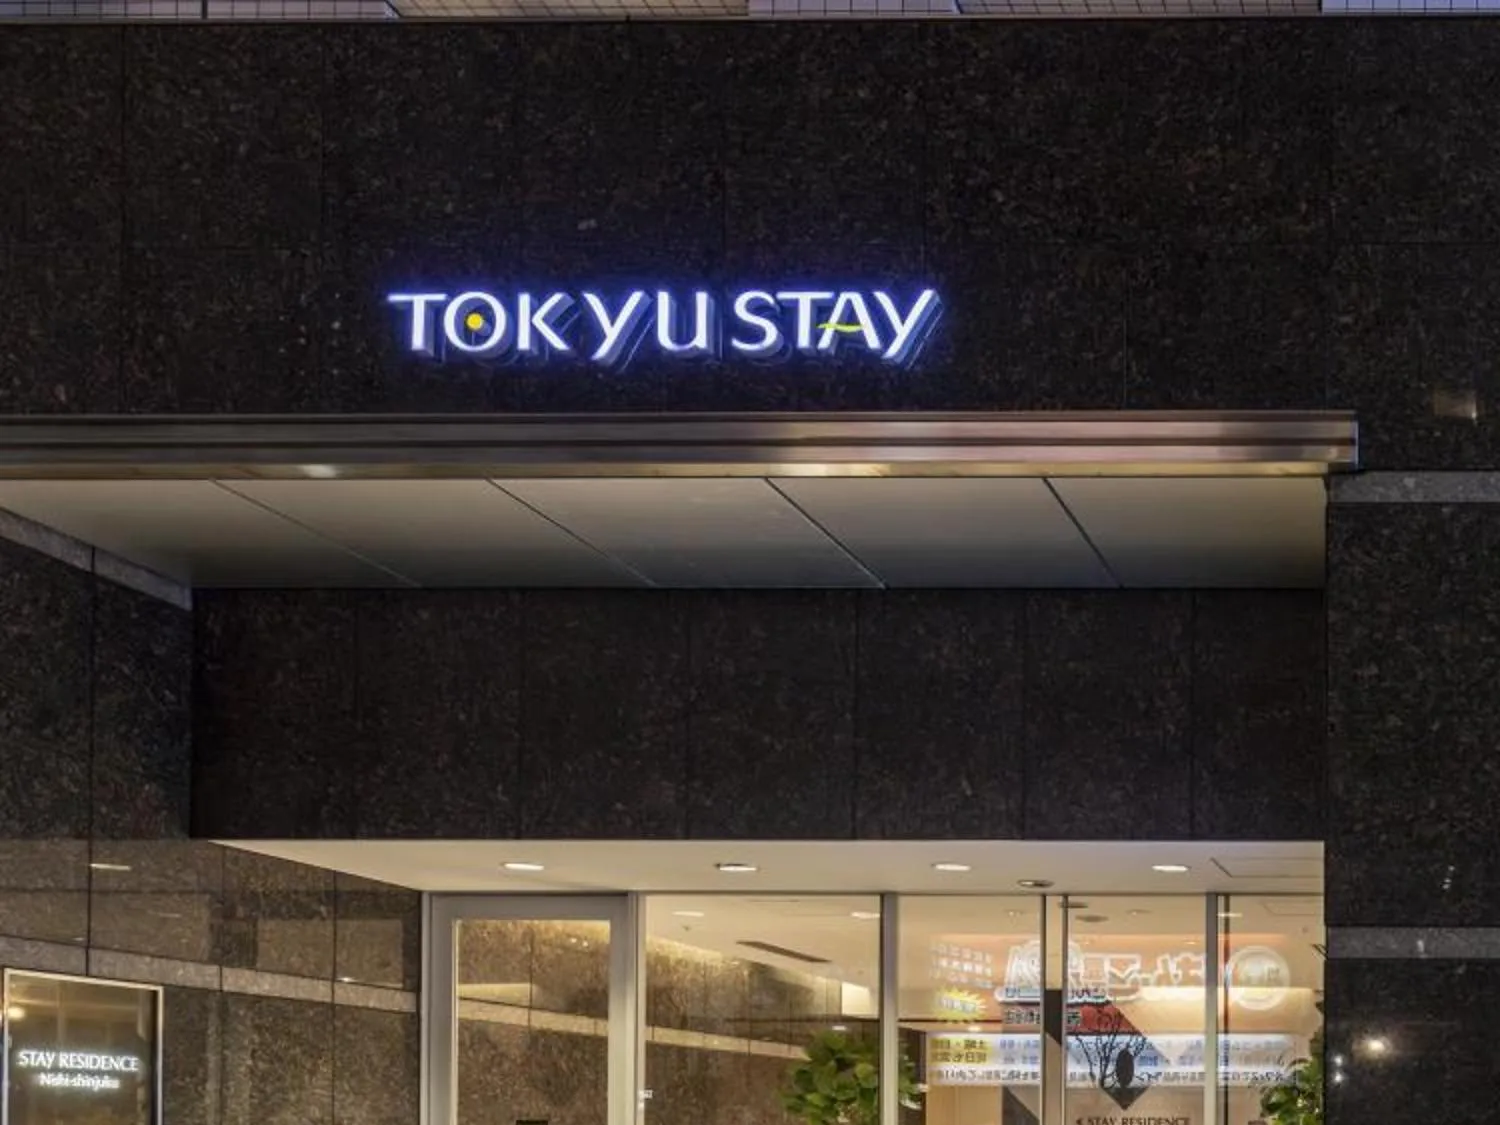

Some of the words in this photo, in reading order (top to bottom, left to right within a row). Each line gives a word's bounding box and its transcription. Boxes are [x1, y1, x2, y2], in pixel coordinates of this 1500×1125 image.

[387, 290, 709, 361] TOKYU
[731, 289, 938, 360] STAY
[18, 1050, 55, 1069] STAY
[58, 1053, 140, 1072] RESIDENCE
